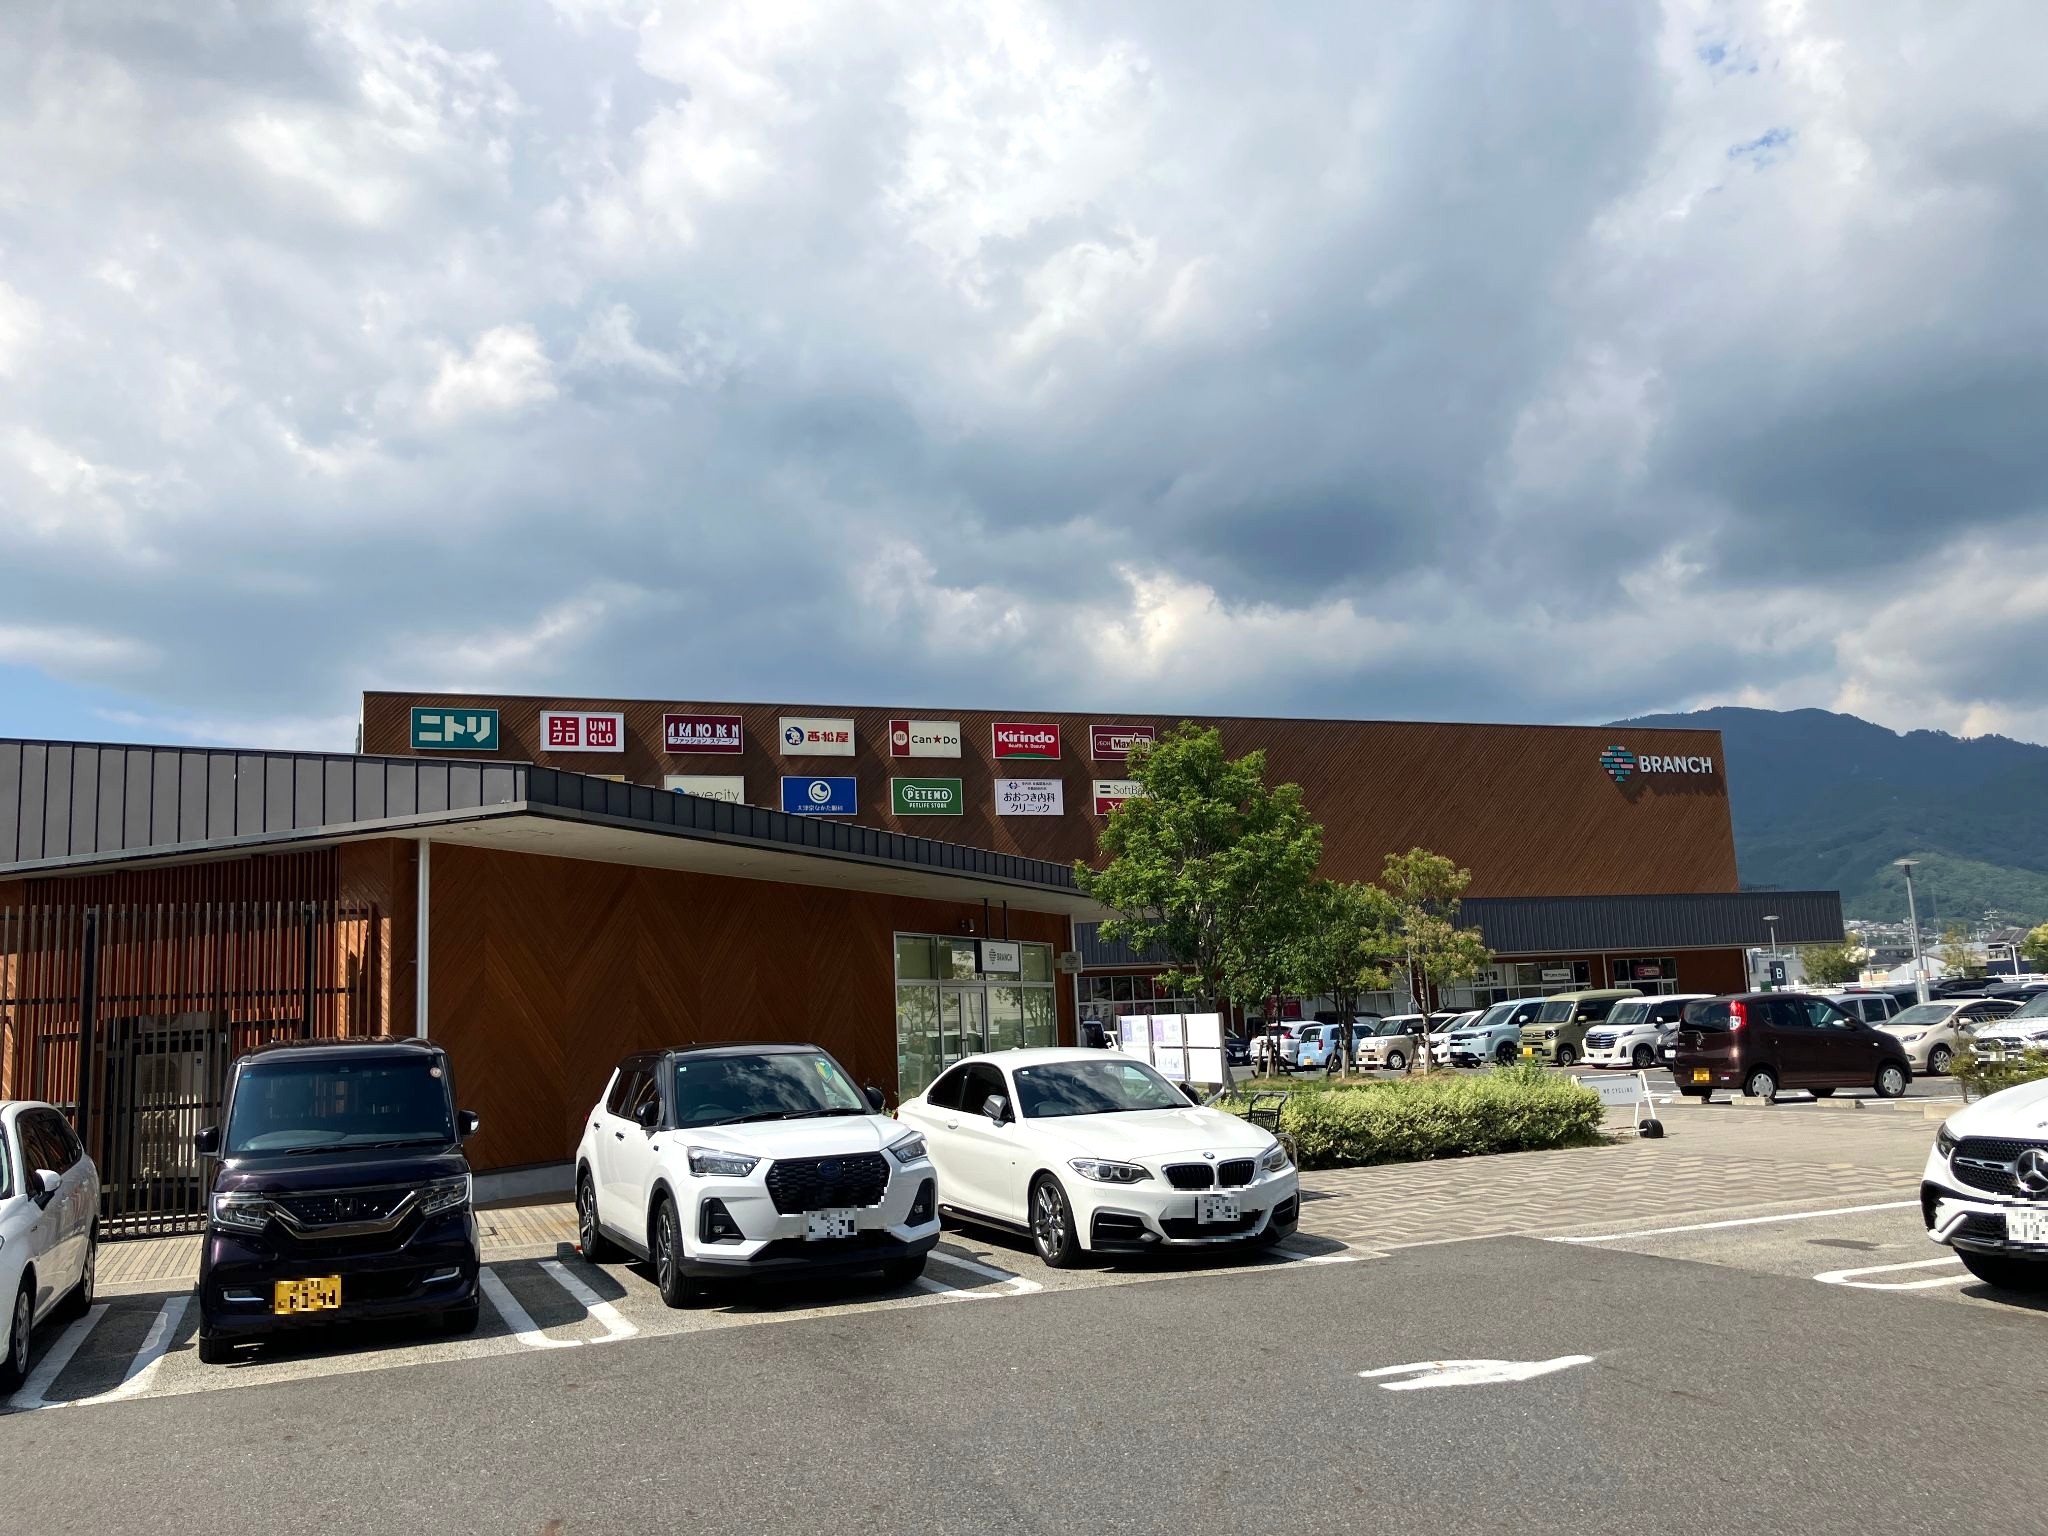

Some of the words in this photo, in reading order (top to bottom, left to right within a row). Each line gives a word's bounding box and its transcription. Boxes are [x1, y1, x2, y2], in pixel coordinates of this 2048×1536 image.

[419, 715, 491, 743] ニトリ
[553, 720, 576, 731] ユニ
[589, 721, 611, 732] UNI
[552, 732, 576, 743] クロ
[589, 733, 614, 744] QLO
[807, 731, 849, 743] 西松屋
[998, 731, 1056, 744] Kirindo
[1639, 755, 1713, 774] BRANCH
[907, 790, 948, 800] PETEMO
[1003, 792, 1056, 803] おおつき内科
[1010, 803, 1050, 813] クリニック
[996, 953, 1013, 961] BRANCH
[1775, 967, 1783, 979] B
